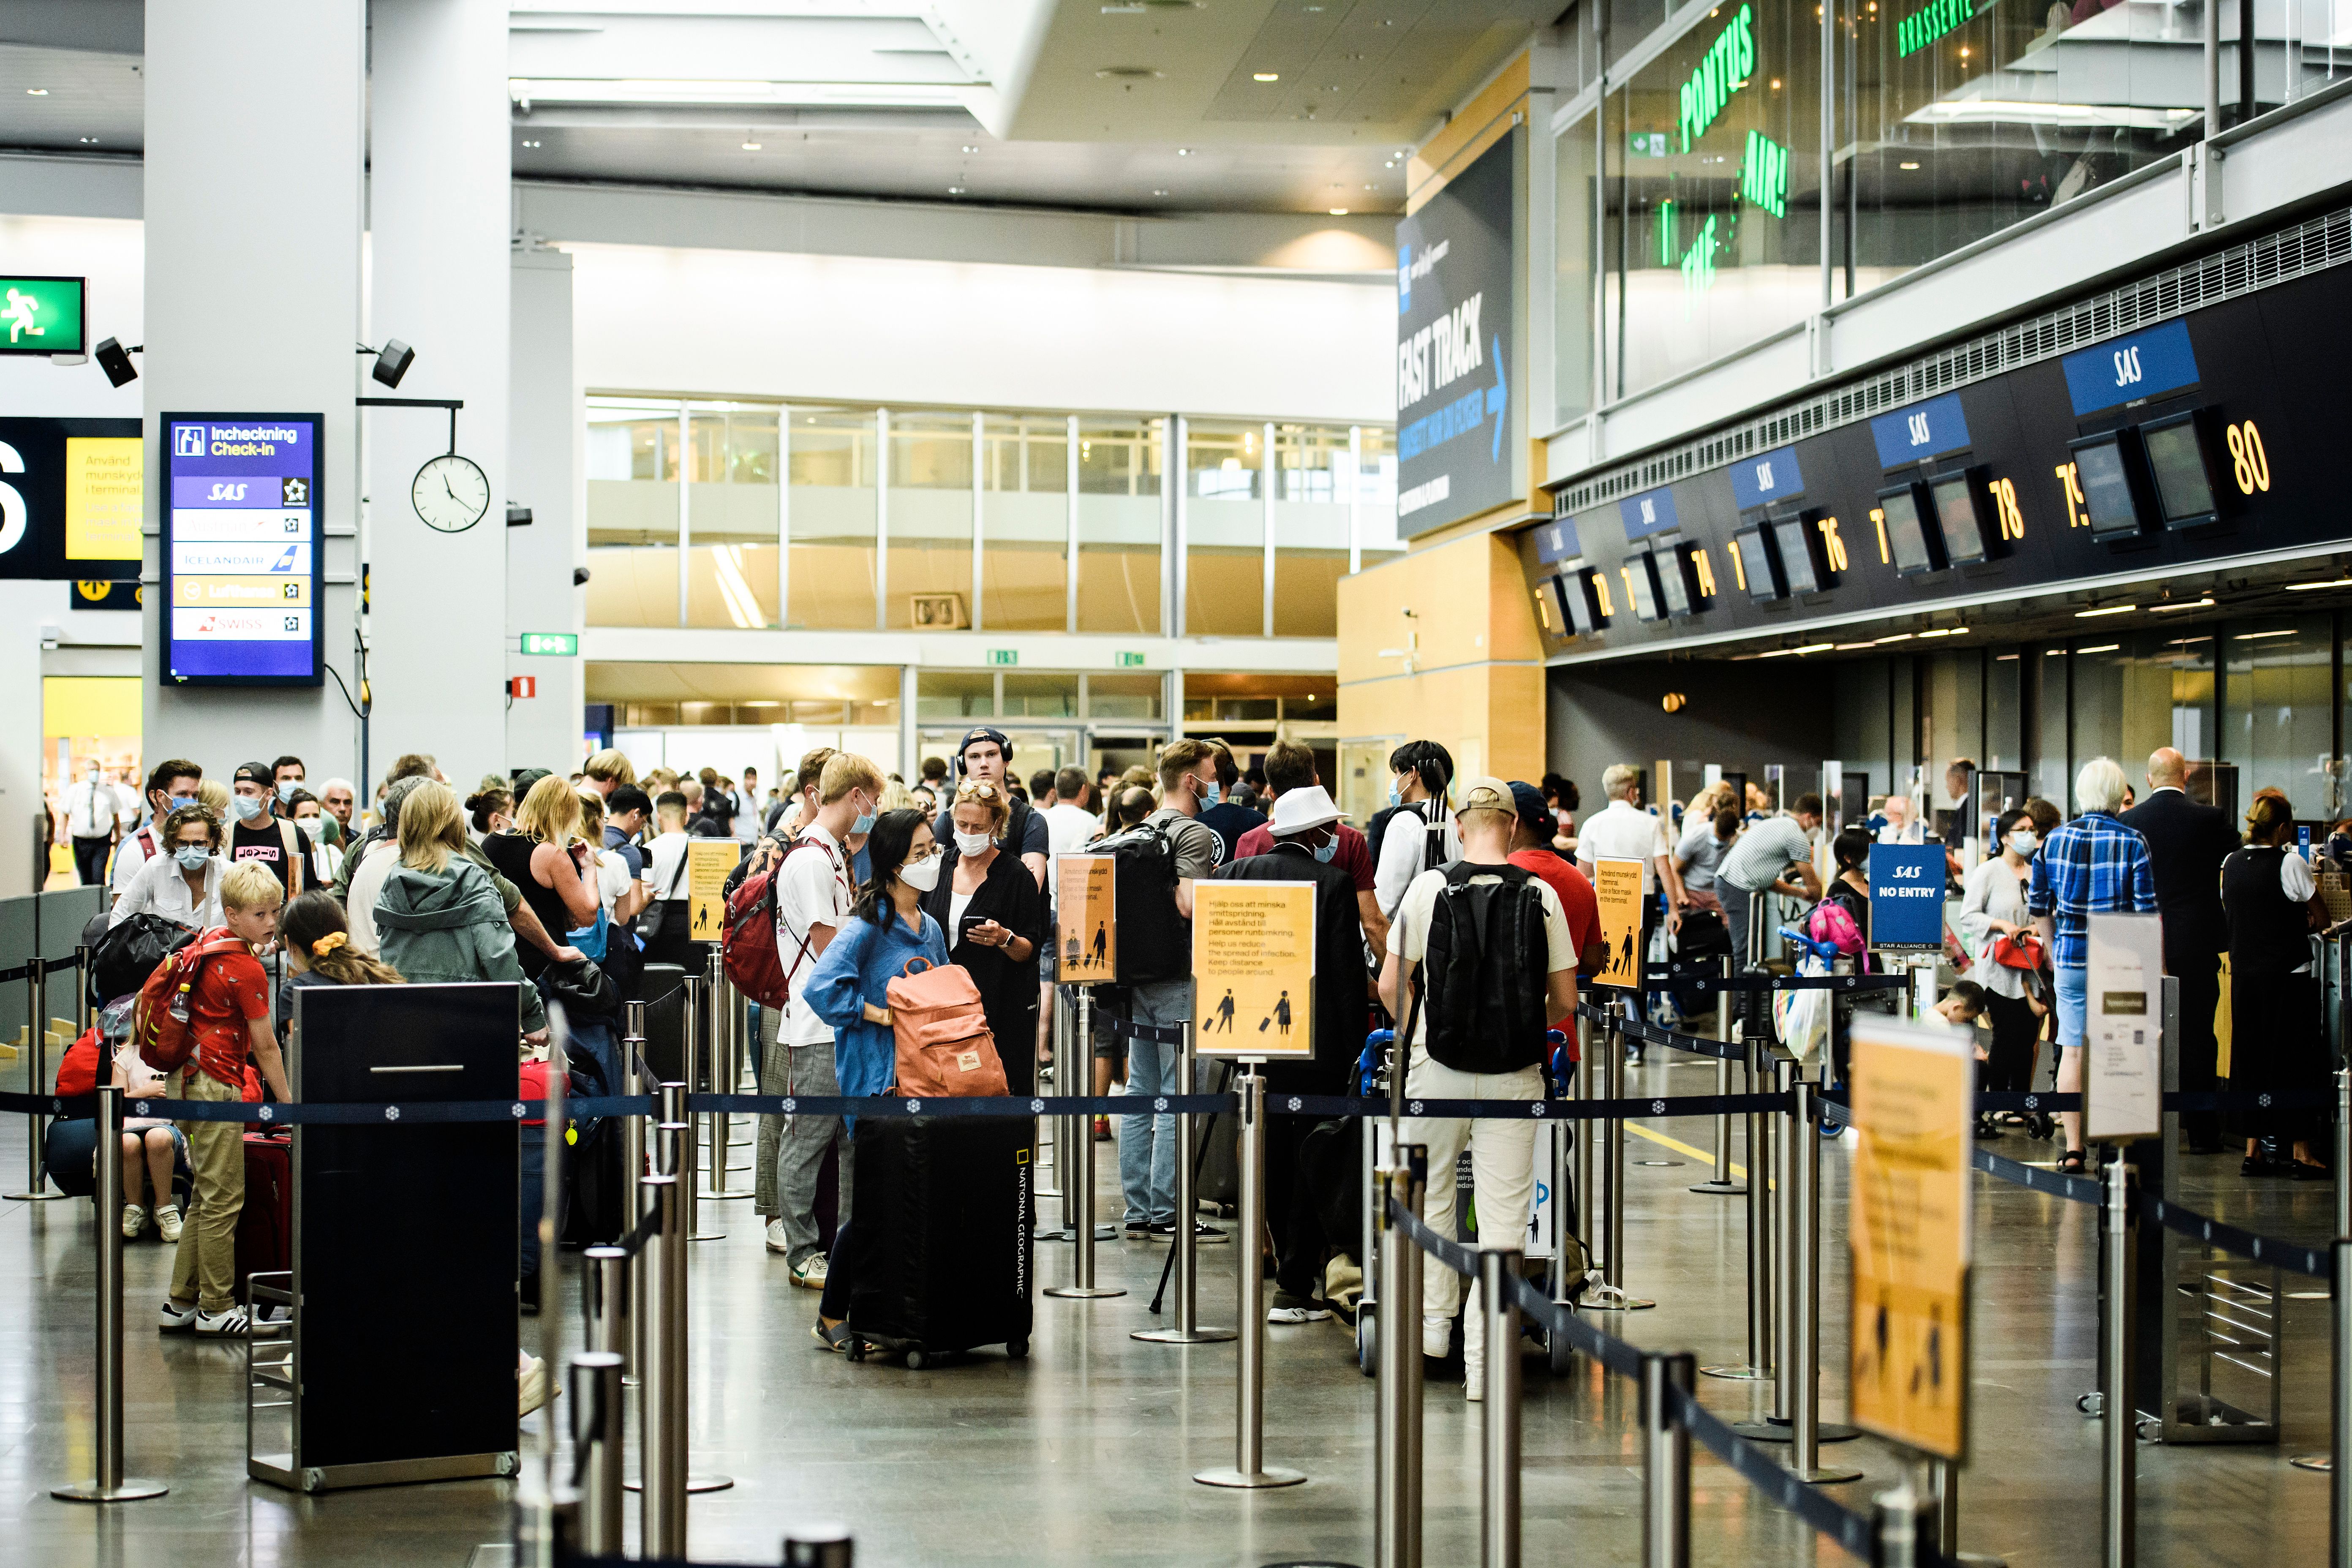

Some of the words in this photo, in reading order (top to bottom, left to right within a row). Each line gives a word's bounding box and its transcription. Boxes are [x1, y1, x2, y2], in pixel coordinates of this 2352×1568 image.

[1681, 3, 1753, 154] PONTUS
[1743, 129, 1787, 218] AIR!
[1399, 325, 1431, 410] FAST
[1432, 292, 1482, 389] TRACK
[2114, 346, 2142, 387] SAS
[212, 426, 297, 444] Incheckning
[1908, 412, 1930, 446] SAS
[86, 456, 130, 466] Använd
[211, 441, 275, 456] Check-in
[2227, 420, 2269, 495] 80
[86, 471, 143, 482] munskyd
[207, 483, 248, 501] SAS
[1989, 478, 2024, 540] 78
[1818, 517, 1848, 572] 76
[185, 555, 264, 565] ICELANDAIR
[1691, 549, 1716, 597] 74
[1592, 573, 1615, 616] 72
[218, 619, 262, 629] SWISS
[1616, 871, 1637, 879] munskydd
[1892, 866, 1922, 878] SAS
[1879, 887, 1897, 897] NO
[1898, 887, 1936, 897] ENTRY
